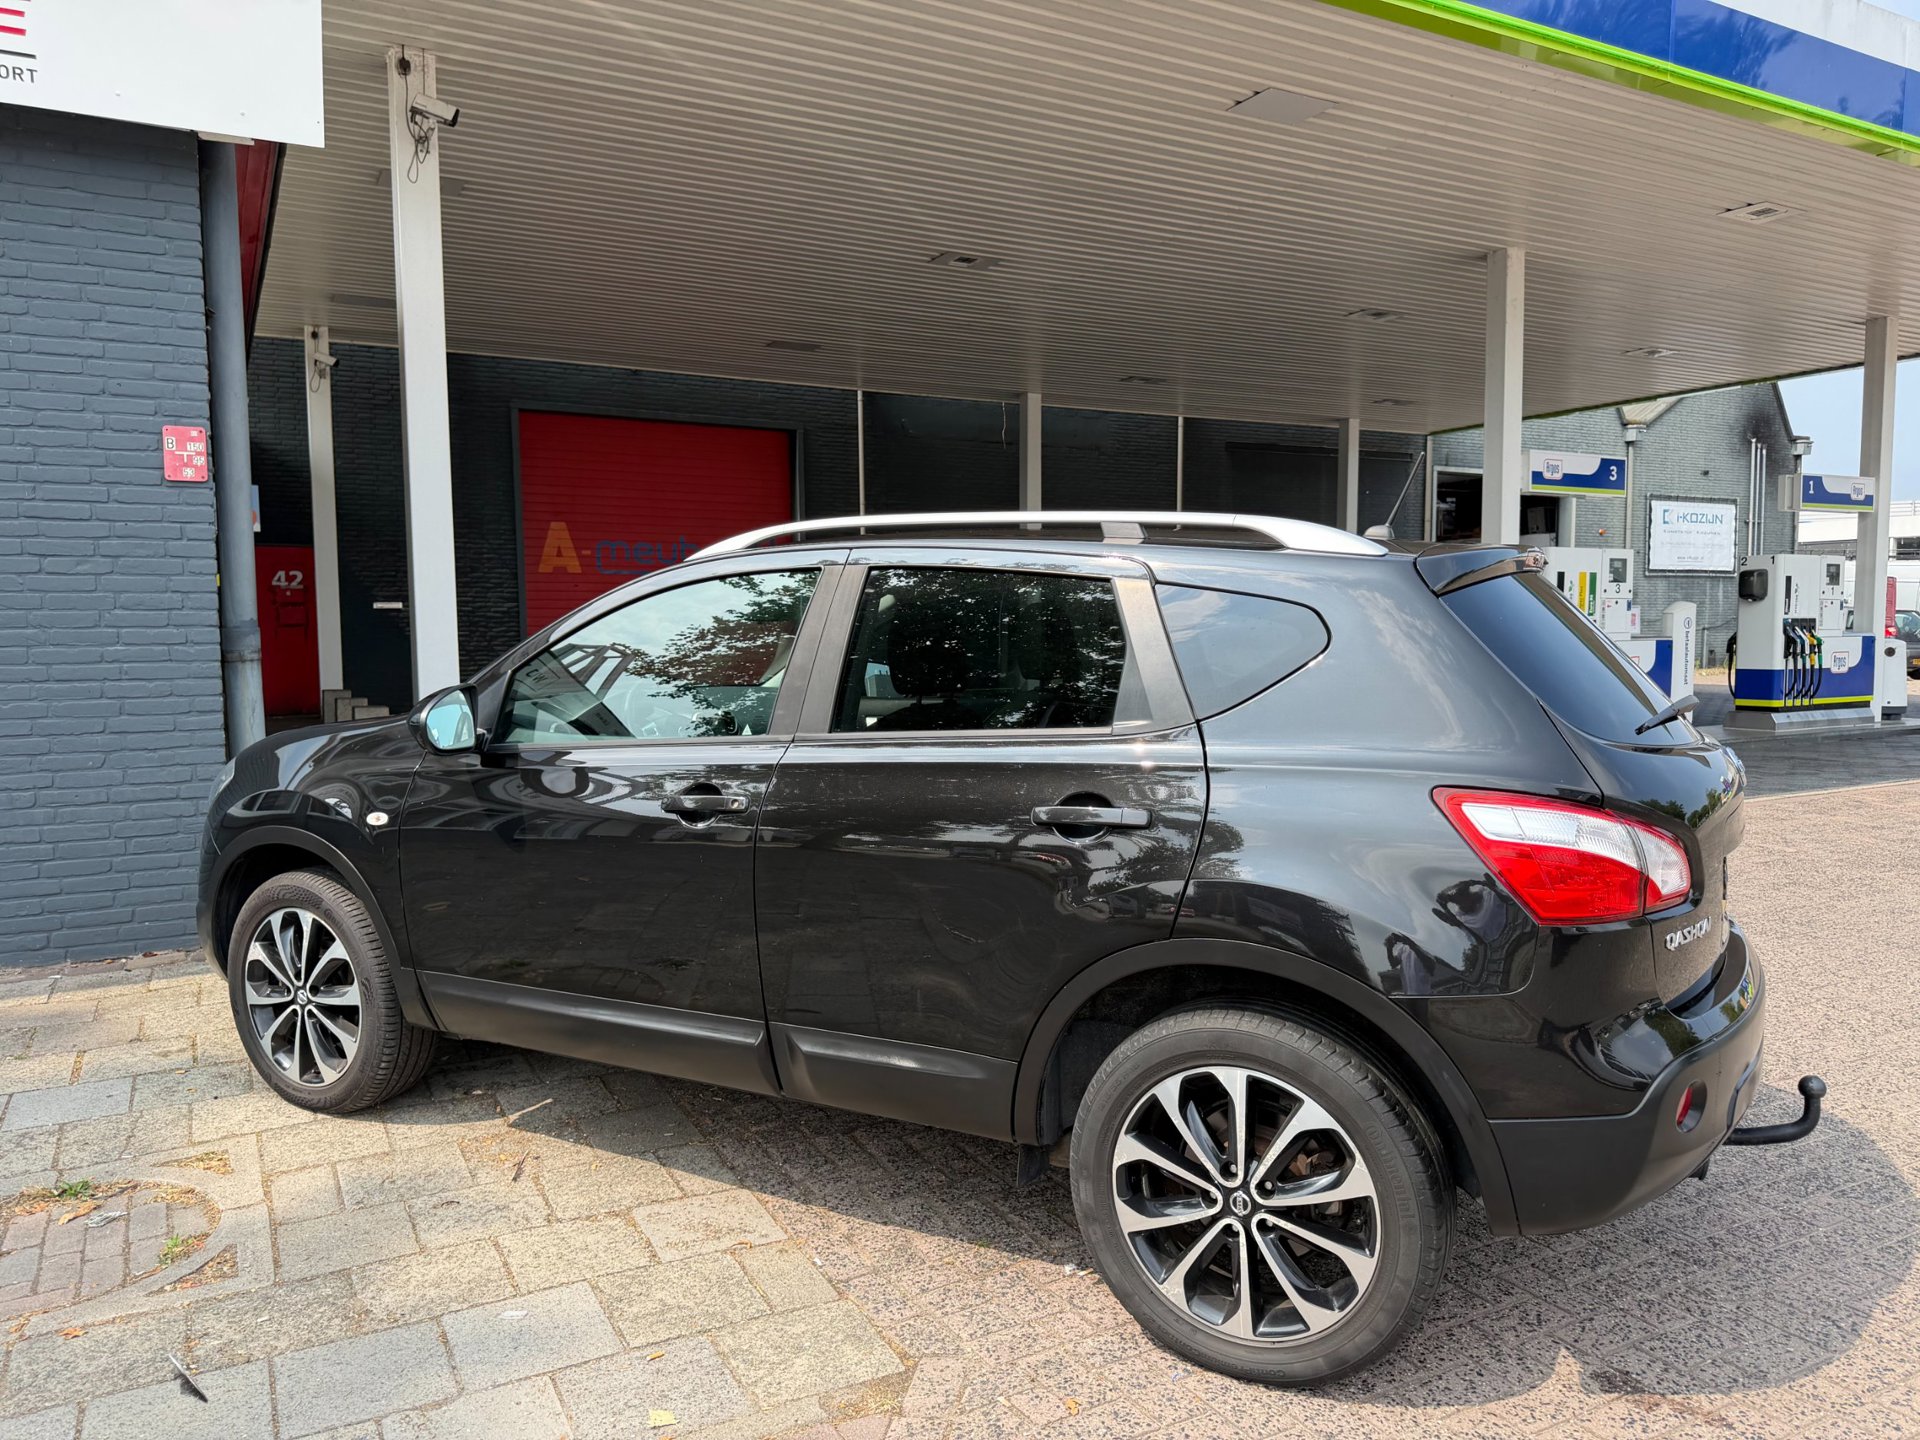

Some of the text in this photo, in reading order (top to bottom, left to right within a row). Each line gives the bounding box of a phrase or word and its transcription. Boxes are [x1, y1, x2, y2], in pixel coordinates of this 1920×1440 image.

[166, 437, 175, 450] B
[1609, 465, 1617, 480] 3
[1808, 480, 1814, 494] 1
[1741, 556, 1748, 566] 2
[1770, 556, 1775, 565] 1
[272, 570, 303, 589] 42
[1615, 583, 1621, 594] 3
